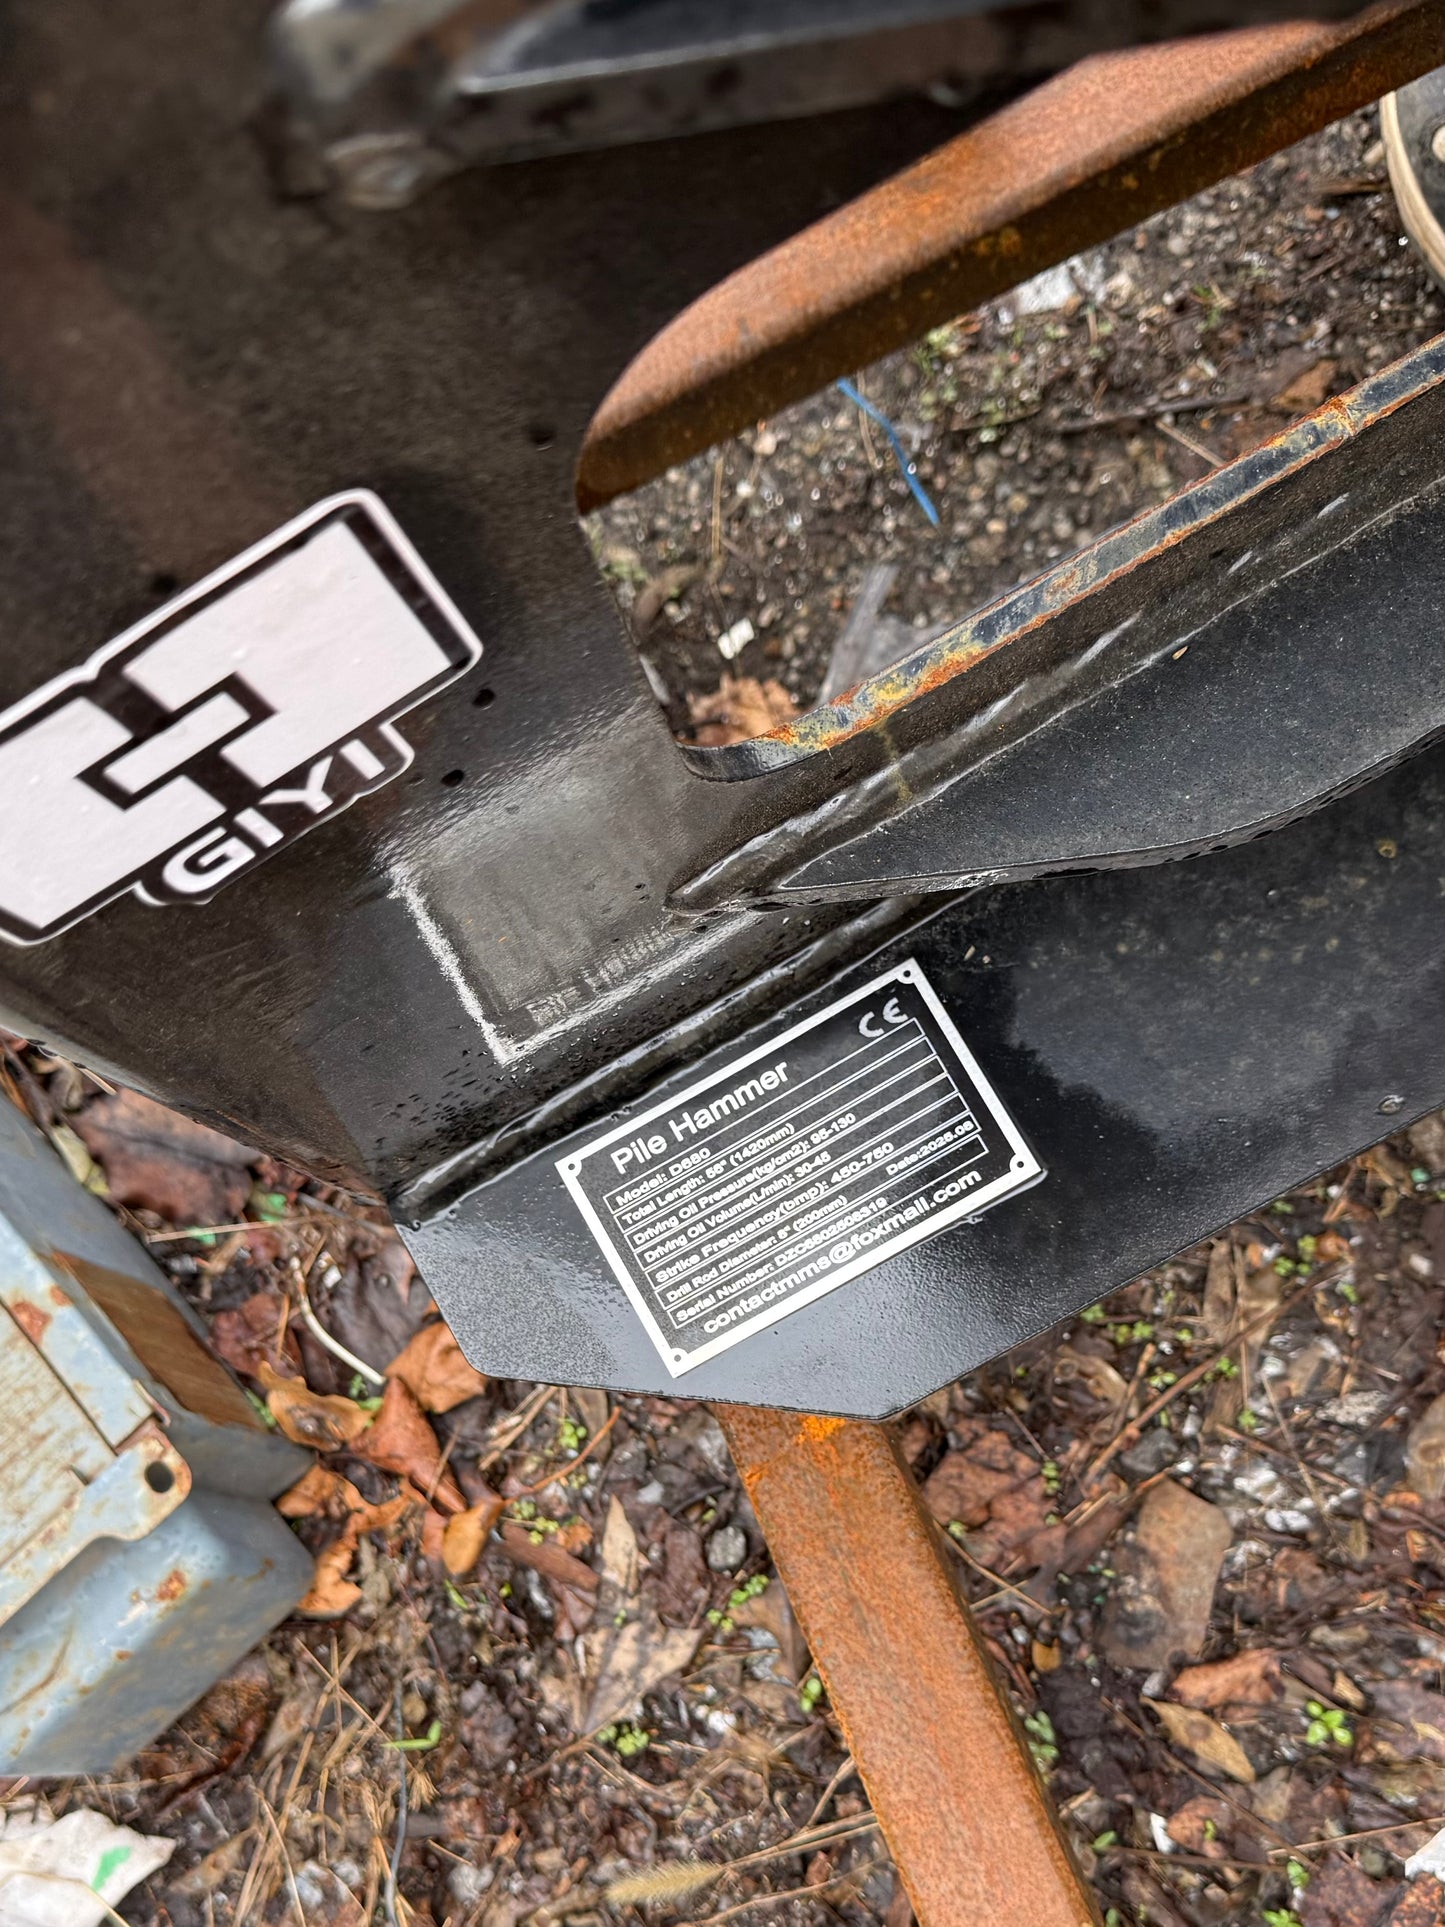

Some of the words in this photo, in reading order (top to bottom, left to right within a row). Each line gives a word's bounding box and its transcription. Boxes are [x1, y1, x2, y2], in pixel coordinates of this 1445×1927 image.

[162, 738, 386, 894] GIYI
[610, 1135, 667, 1174] Pile
[668, 1061, 788, 1141] Hammer
[621, 1200, 657, 1224] Total
[655, 1174, 705, 1206] Length:
[729, 1122, 794, 1166] (1420mm)
[615, 1173, 667, 1206] Model:
[668, 1147, 710, 1176] D680
[632, 1215, 679, 1245] Driving
[678, 1202, 698, 1218] Oil
[809, 1112, 859, 1144] 95-130
[643, 1234, 688, 1262] Driving
[686, 1221, 706, 1238] Oil
[793, 1150, 831, 1177] 30-45
[655, 1254, 700, 1282] Strike
[830, 1142, 898, 1183] 450-750
[665, 1282, 692, 1302] Drill
[691, 1267, 719, 1287] Rod
[718, 1235, 777, 1273] Diameter:
[792, 1194, 850, 1234] (200mm)
[675, 1290, 721, 1321] Serial
[717, 1262, 774, 1298] Number:
[703, 1170, 981, 1333] contactmms@foxmail.com
